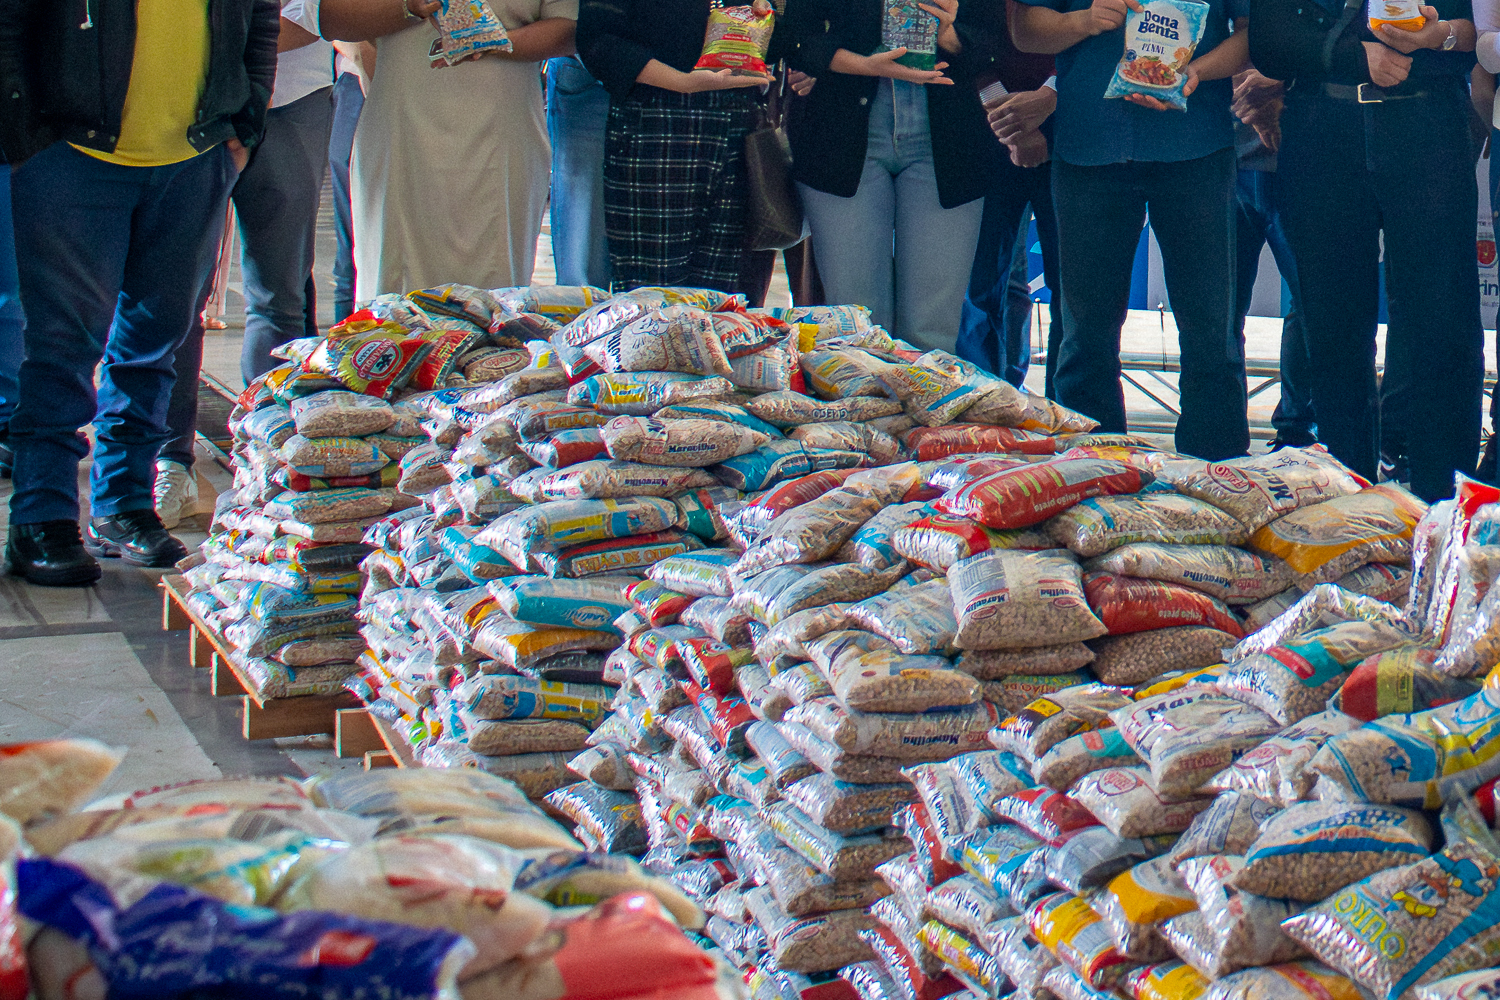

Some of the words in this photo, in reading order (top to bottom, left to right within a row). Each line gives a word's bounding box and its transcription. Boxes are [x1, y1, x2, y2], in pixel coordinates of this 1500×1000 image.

[1143, 10, 1179, 30] Dona
[1137, 20, 1179, 41] Benta
[669, 443, 716, 453] Maravilha
[1056, 492, 1081, 506] Feijão
[1183, 570, 1231, 588] Maravilha
[903, 734, 960, 747] Maravilha
[1335, 893, 1406, 959] OURO
